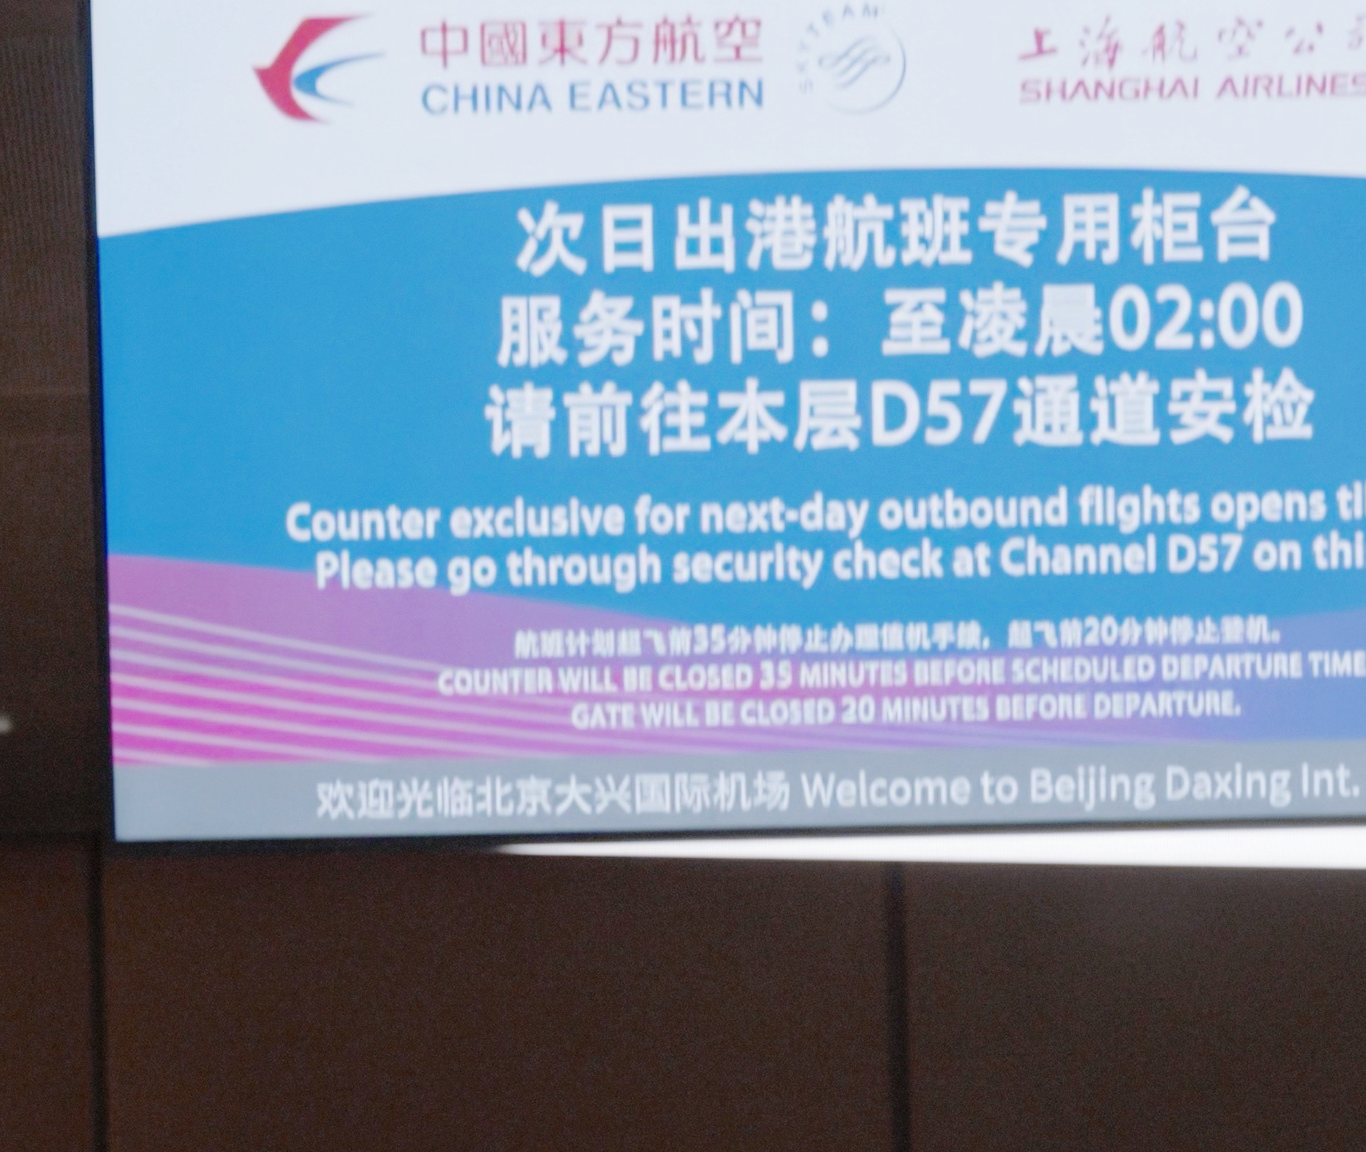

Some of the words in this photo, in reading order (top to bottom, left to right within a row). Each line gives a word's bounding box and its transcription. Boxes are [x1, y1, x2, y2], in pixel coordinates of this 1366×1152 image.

[420, 15, 764, 69] 中國東方航空
[422, 80, 552, 116] CHINA
[570, 78, 764, 112] EASTERN
[1020, 75, 1200, 103] SHANGHAI
[515, 186, 1276, 276] 次日出港航班专用柜台
[485, 367, 1314, 458] 请前往本层D57通道安检
[286, 502, 439, 543] Counter
[449, 498, 625, 538] exclusive
[635, 494, 690, 534] for
[701, 491, 869, 537] next-day
[879, 486, 1068, 530] outbound
[1078, 484, 1200, 533] flights
[1211, 484, 1327, 530] opens
[316, 550, 437, 591] Please
[448, 554, 496, 597] go
[506, 544, 660, 593] through
[672, 541, 823, 589] security
[833, 536, 942, 580] check
[953, 539, 991, 576] at
[1001, 534, 1156, 575] Channel
[1167, 533, 1242, 572] D57
[1253, 538, 1302, 570] on
[439, 668, 553, 695] COUNTER
[558, 667, 617, 693] WILL
[623, 666, 656, 691] BE
[658, 664, 752, 691] CLOSED
[759, 662, 793, 688] 35
[800, 660, 908, 688] MINUTES
[915, 659, 1005, 685] BEFORE
[1011, 655, 1156, 684] SCHEDULED
[1163, 652, 1302, 681] DEPARTURE
[571, 703, 635, 730] GATE
[641, 701, 699, 728] WILL
[705, 700, 737, 727] BE
[740, 699, 834, 726] CLOSED
[842, 697, 875, 724] 20
[882, 695, 990, 722] MINUTES
[996, 693, 1087, 720] BEFORE
[1093, 690, 1241, 719] DEPARTURE.
[317, 771, 789, 820] 欢迎光临北京大兴国际机场
[801, 772, 972, 810] Welcome
[981, 771, 1019, 805] to
[1032, 765, 1155, 811] Beijing
[1166, 761, 1290, 808] Daxing
[1302, 761, 1360, 798] Int.
